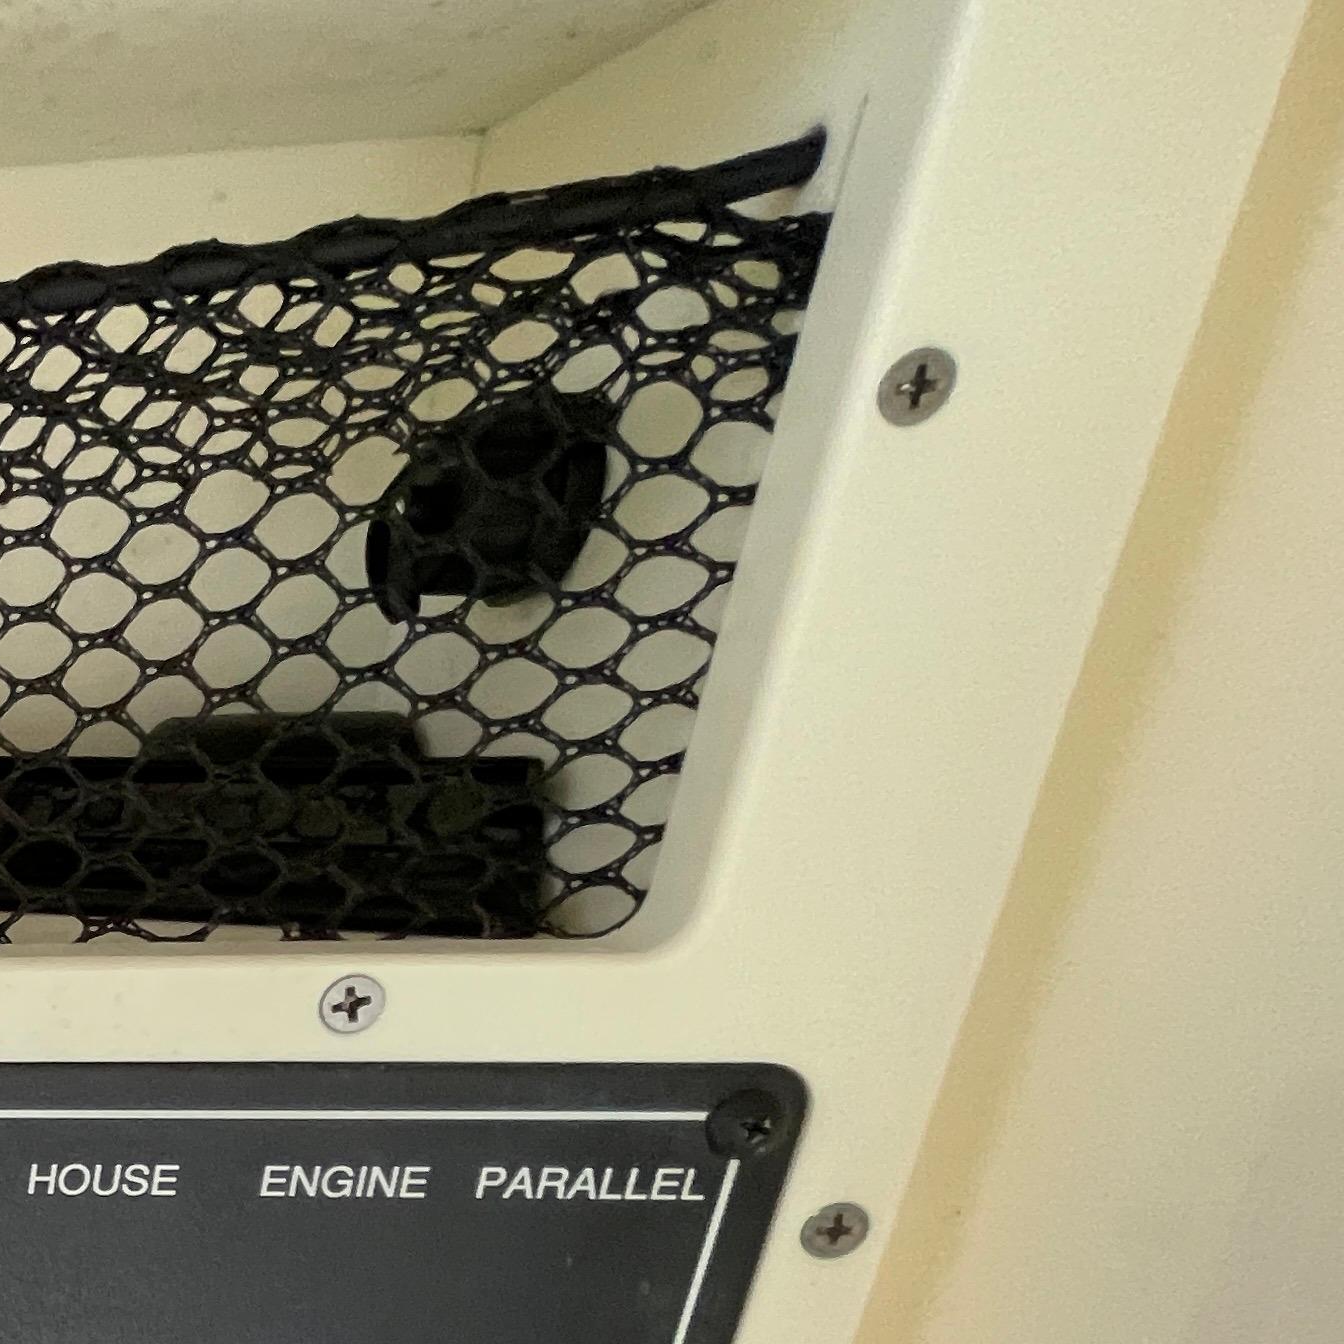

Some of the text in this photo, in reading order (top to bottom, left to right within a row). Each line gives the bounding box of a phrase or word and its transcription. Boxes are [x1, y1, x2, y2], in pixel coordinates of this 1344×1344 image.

[28, 1164, 179, 1196] HOUSE
[260, 1166, 430, 1198] ENGINE
[476, 1167, 705, 1200] PARALLEL
